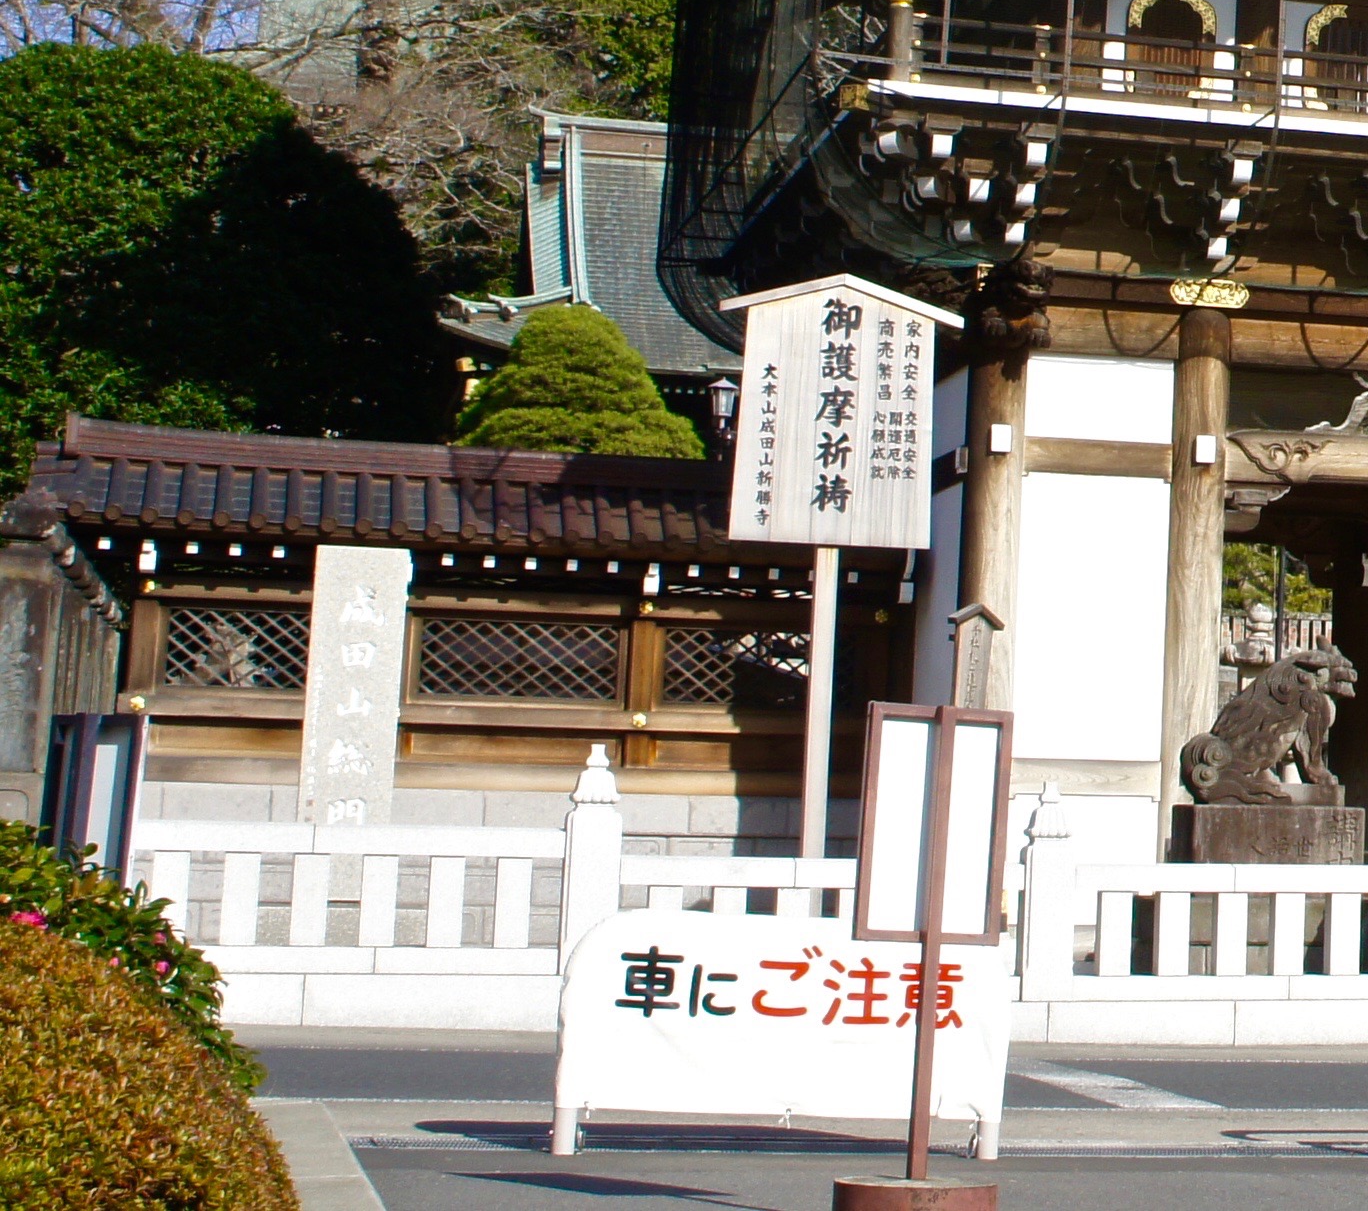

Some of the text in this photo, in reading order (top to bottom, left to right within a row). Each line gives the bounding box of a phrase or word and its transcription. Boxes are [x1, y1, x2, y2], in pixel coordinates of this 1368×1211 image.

[876, 318, 896, 401] 商売繁昌
[900, 319, 923, 402] 家内安全
[754, 362, 779, 526] 大本山成田山新勝寺
[810, 297, 863, 514] 御護摩祈祷
[902, 410, 918, 481] 交通安全
[326, 585, 385, 825] 成田山総門
[614, 944, 965, 1030] 車にご注意
